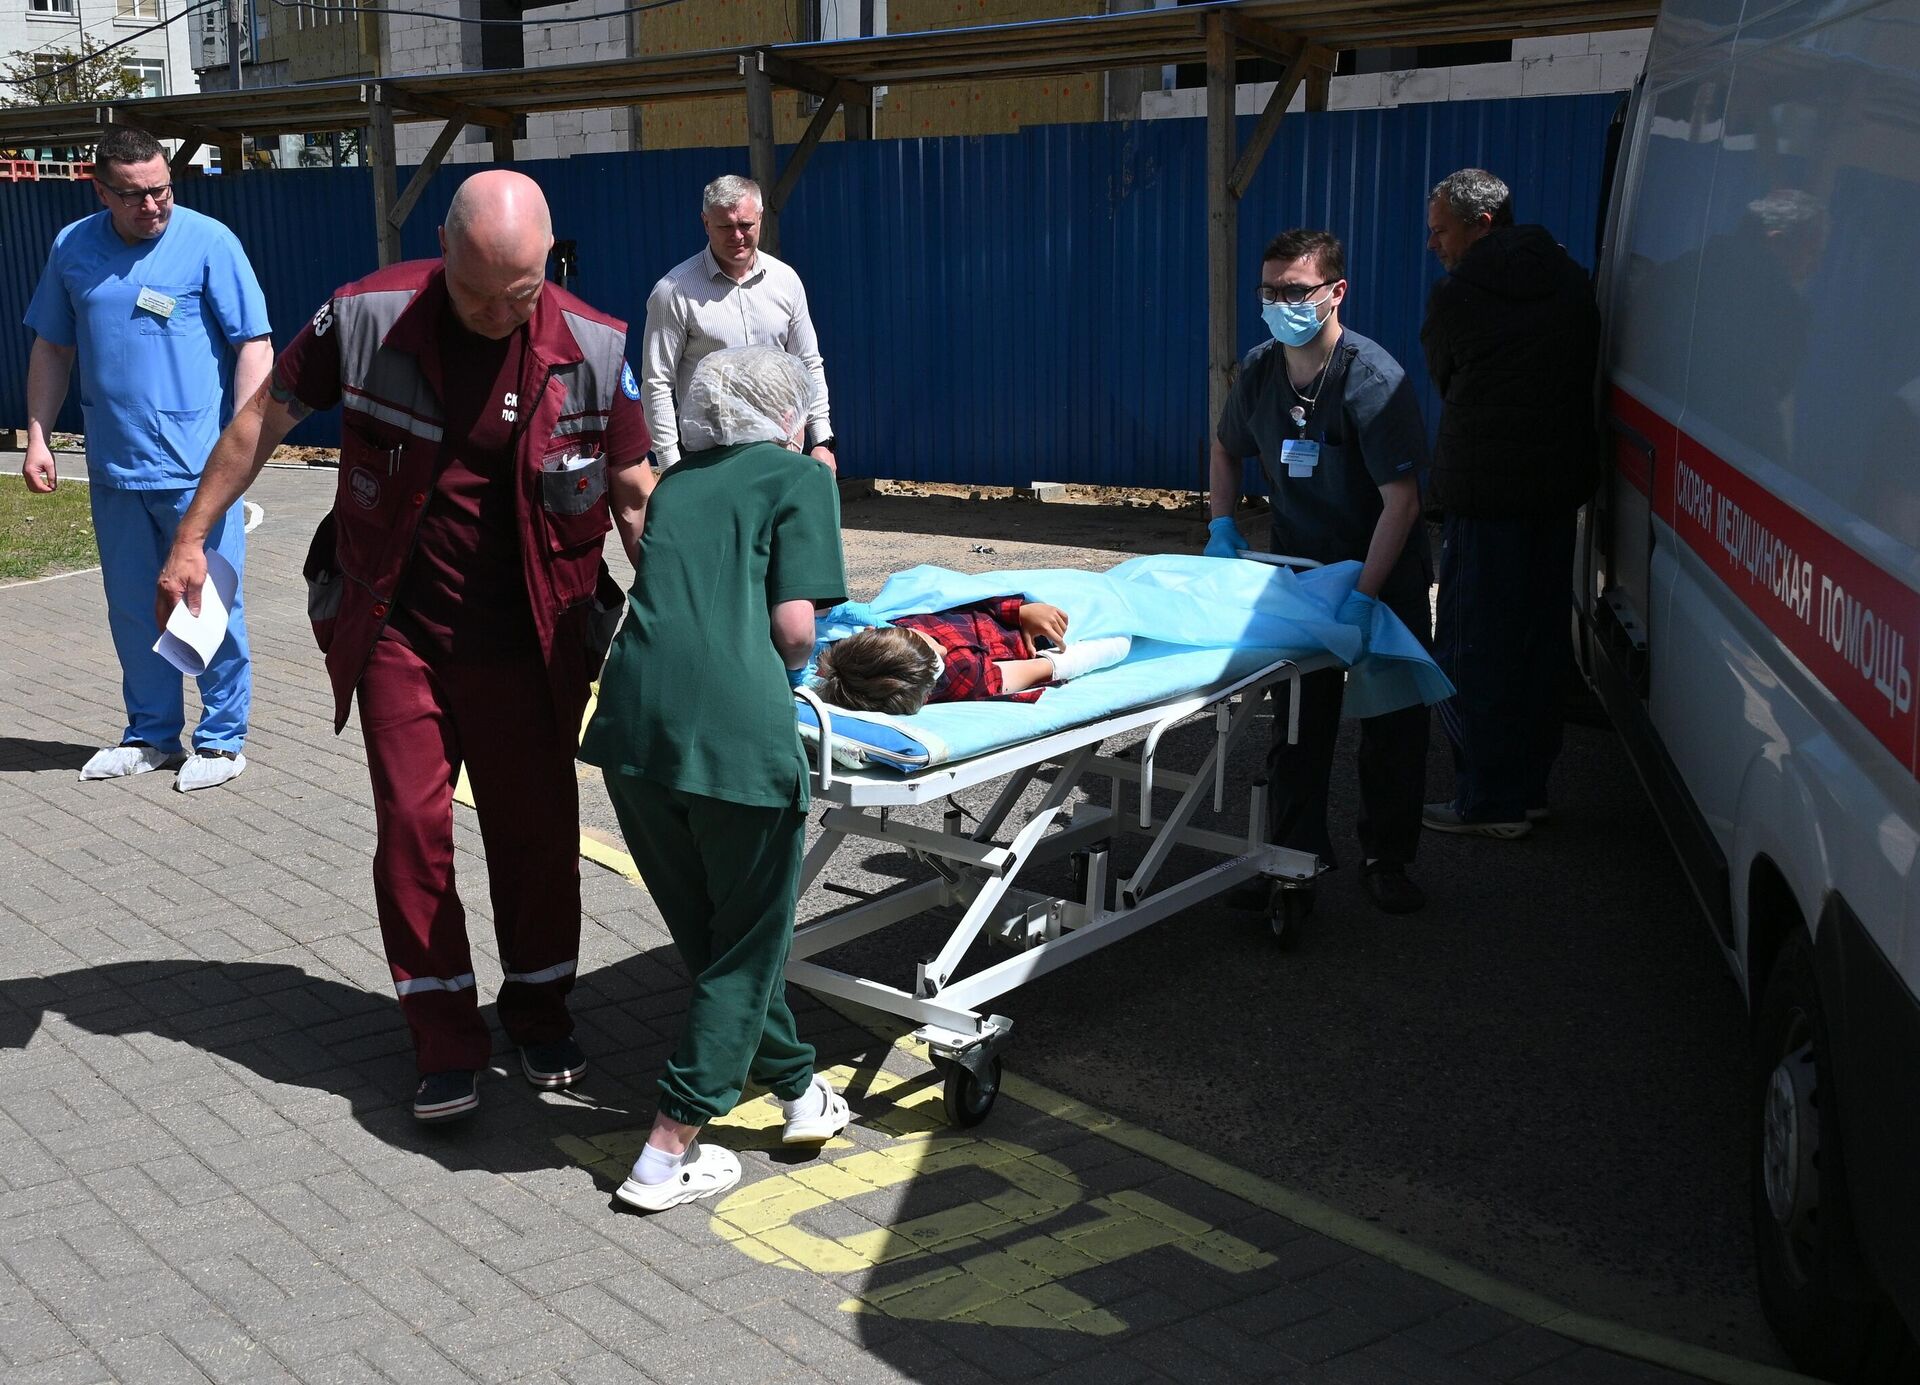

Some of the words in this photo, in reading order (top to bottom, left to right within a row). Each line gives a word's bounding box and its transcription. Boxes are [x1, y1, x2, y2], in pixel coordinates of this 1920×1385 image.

[313, 298, 333, 337] 03
[1677, 460, 1712, 533] СКОРАЯ
[1716, 492, 1813, 625] МЕДИЦИНСКАЯ
[1819, 574, 1911, 718] ПОМОЩЬ
